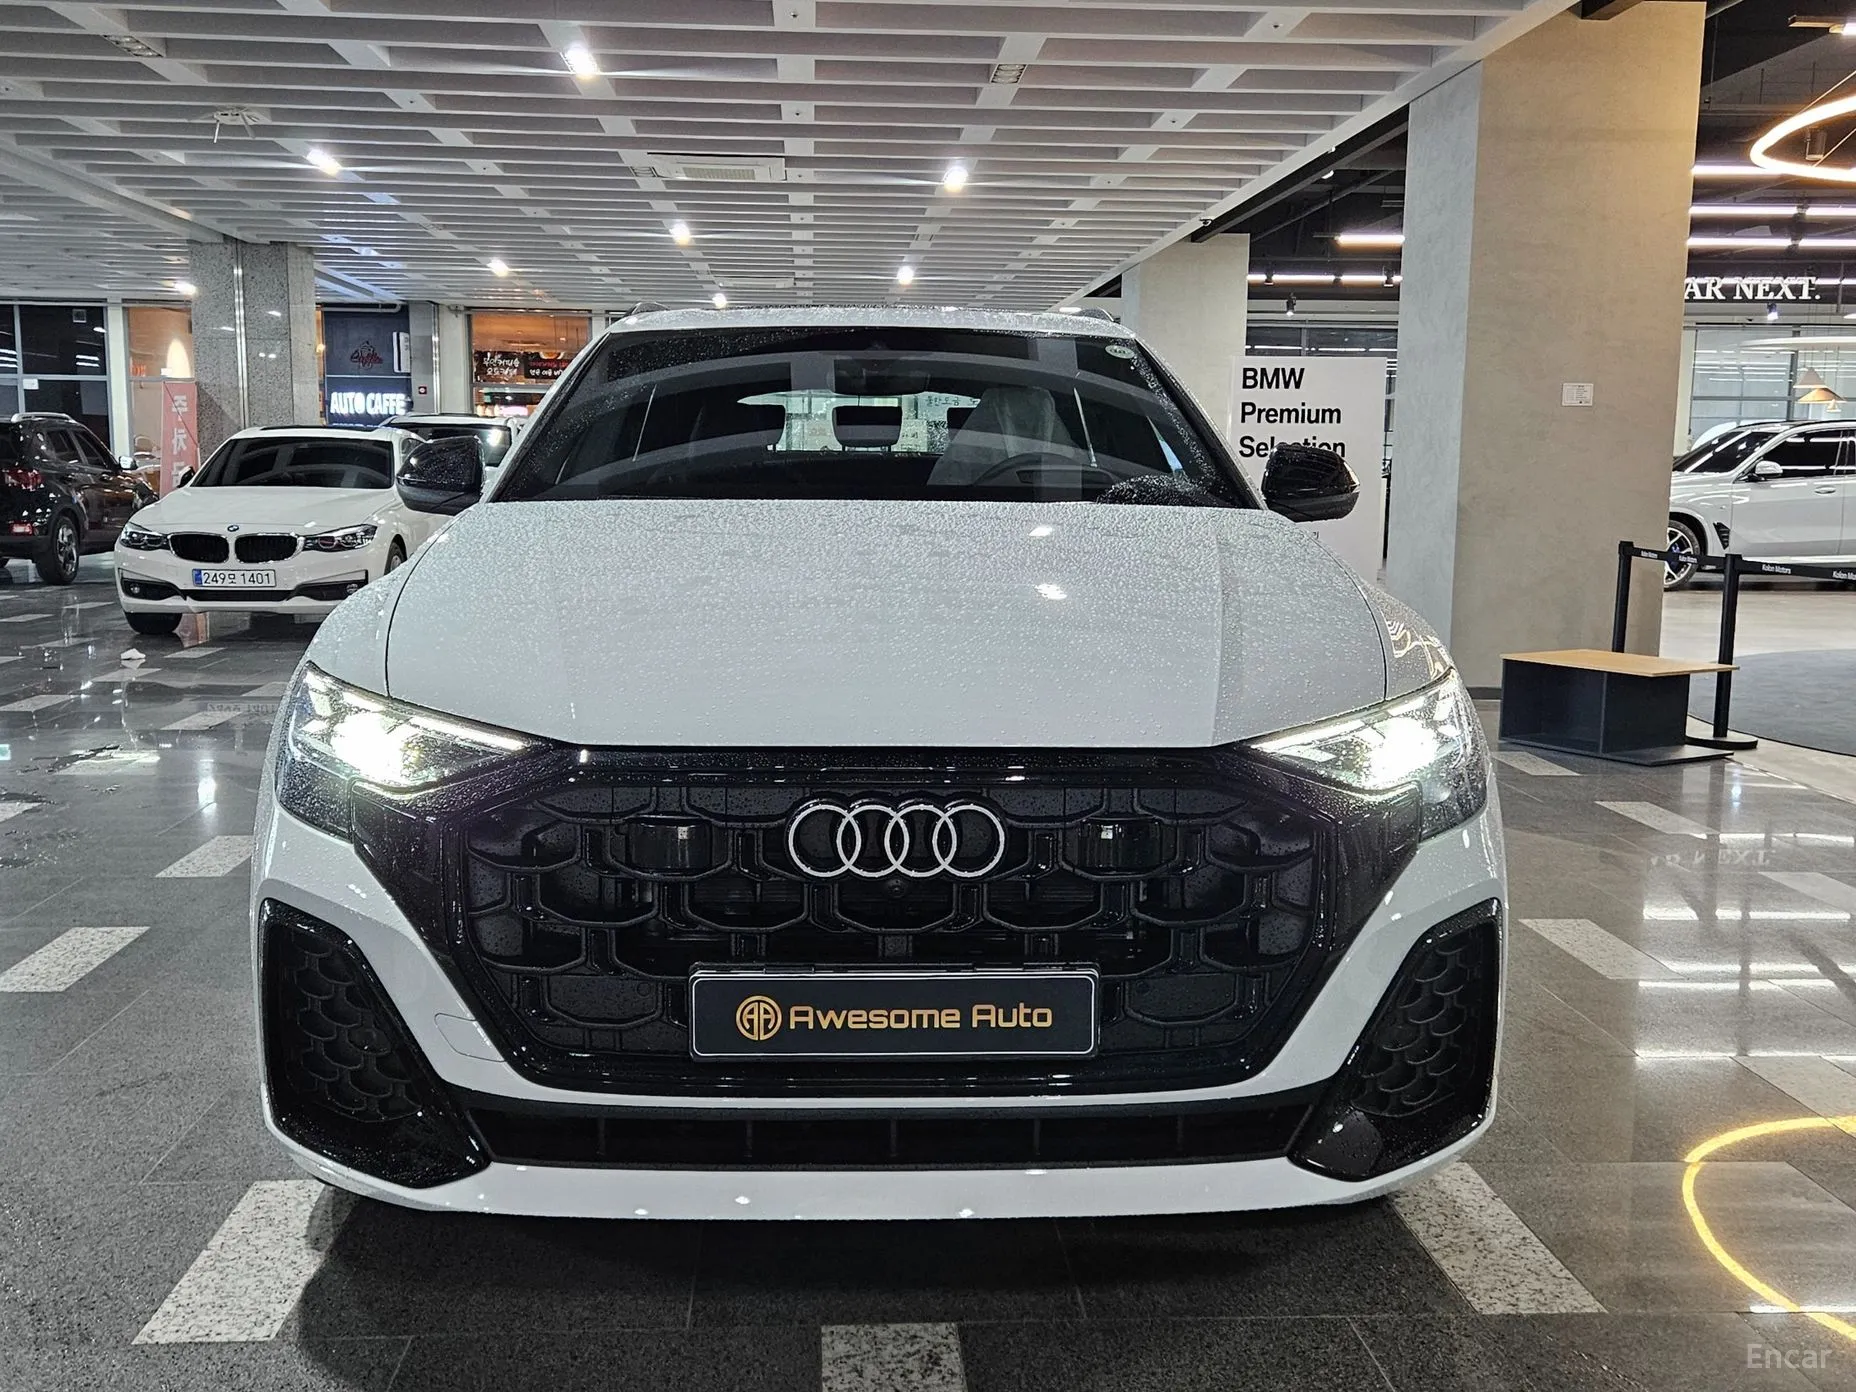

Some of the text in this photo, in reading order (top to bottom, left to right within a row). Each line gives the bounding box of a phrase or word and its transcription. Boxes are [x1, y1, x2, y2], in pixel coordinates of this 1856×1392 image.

[1733, 276, 1821, 300] NEXT.
[1242, 367, 1305, 390] BMW
[330, 391, 406, 416] AUTO CAFFE
[1240, 401, 1342, 425] Premium
[203, 572, 271, 585] 249모 1401
[789, 1005, 961, 1030] Awesome
[971, 1002, 1053, 1029] Auto
